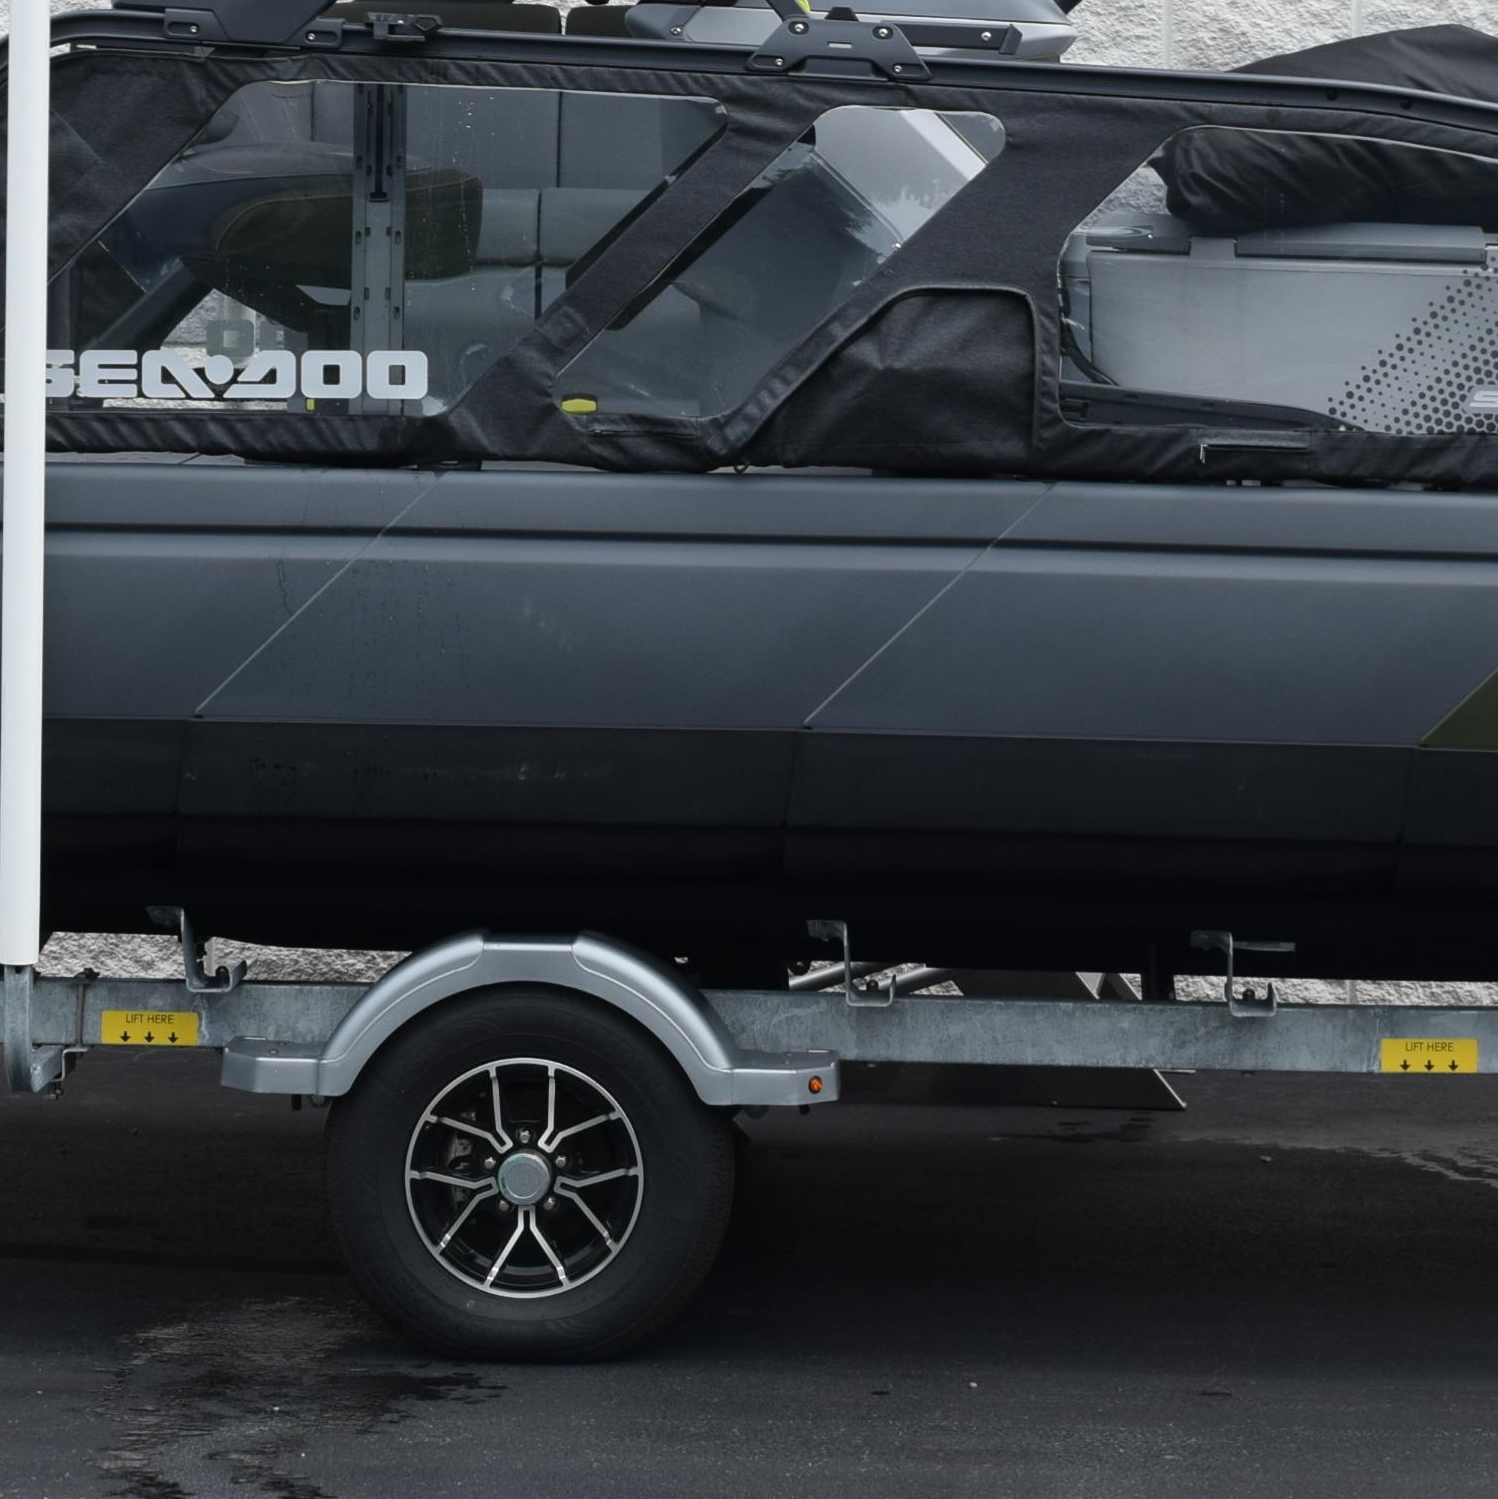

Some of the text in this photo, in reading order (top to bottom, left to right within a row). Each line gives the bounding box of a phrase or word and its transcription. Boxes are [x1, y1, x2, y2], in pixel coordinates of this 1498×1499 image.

[125, 1014, 174, 1025] LIFT HERE
[1405, 1041, 1454, 1052] LIFT HERE
